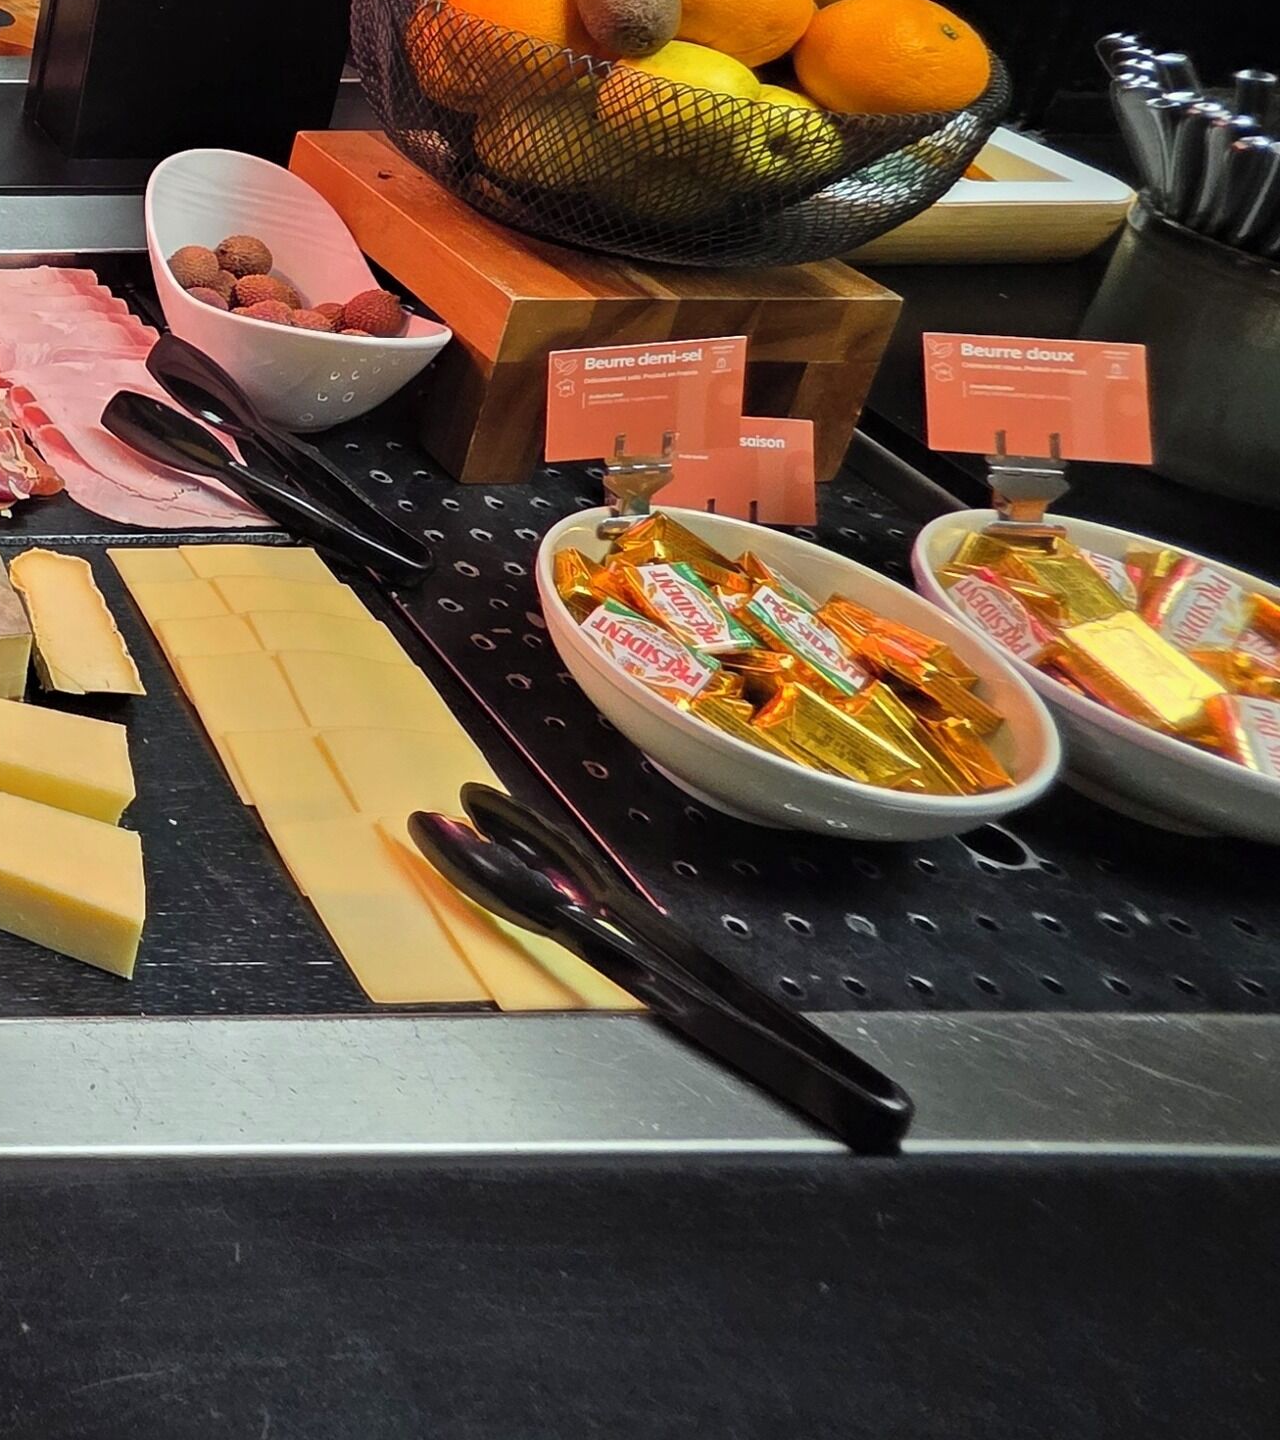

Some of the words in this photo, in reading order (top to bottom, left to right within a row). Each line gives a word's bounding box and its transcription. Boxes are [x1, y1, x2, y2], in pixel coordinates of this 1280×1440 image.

[584, 356, 635, 370] Beurre
[637, 348, 703, 366] demi-sel
[960, 342, 1023, 360] Beurre
[1026, 347, 1075, 362] doux
[739, 435, 785, 448] saison
[648, 570, 724, 645] PRÉSIDENT
[955, 580, 1032, 655] PRÉSIDENT
[591, 615, 704, 688] PRÉSIDENT
